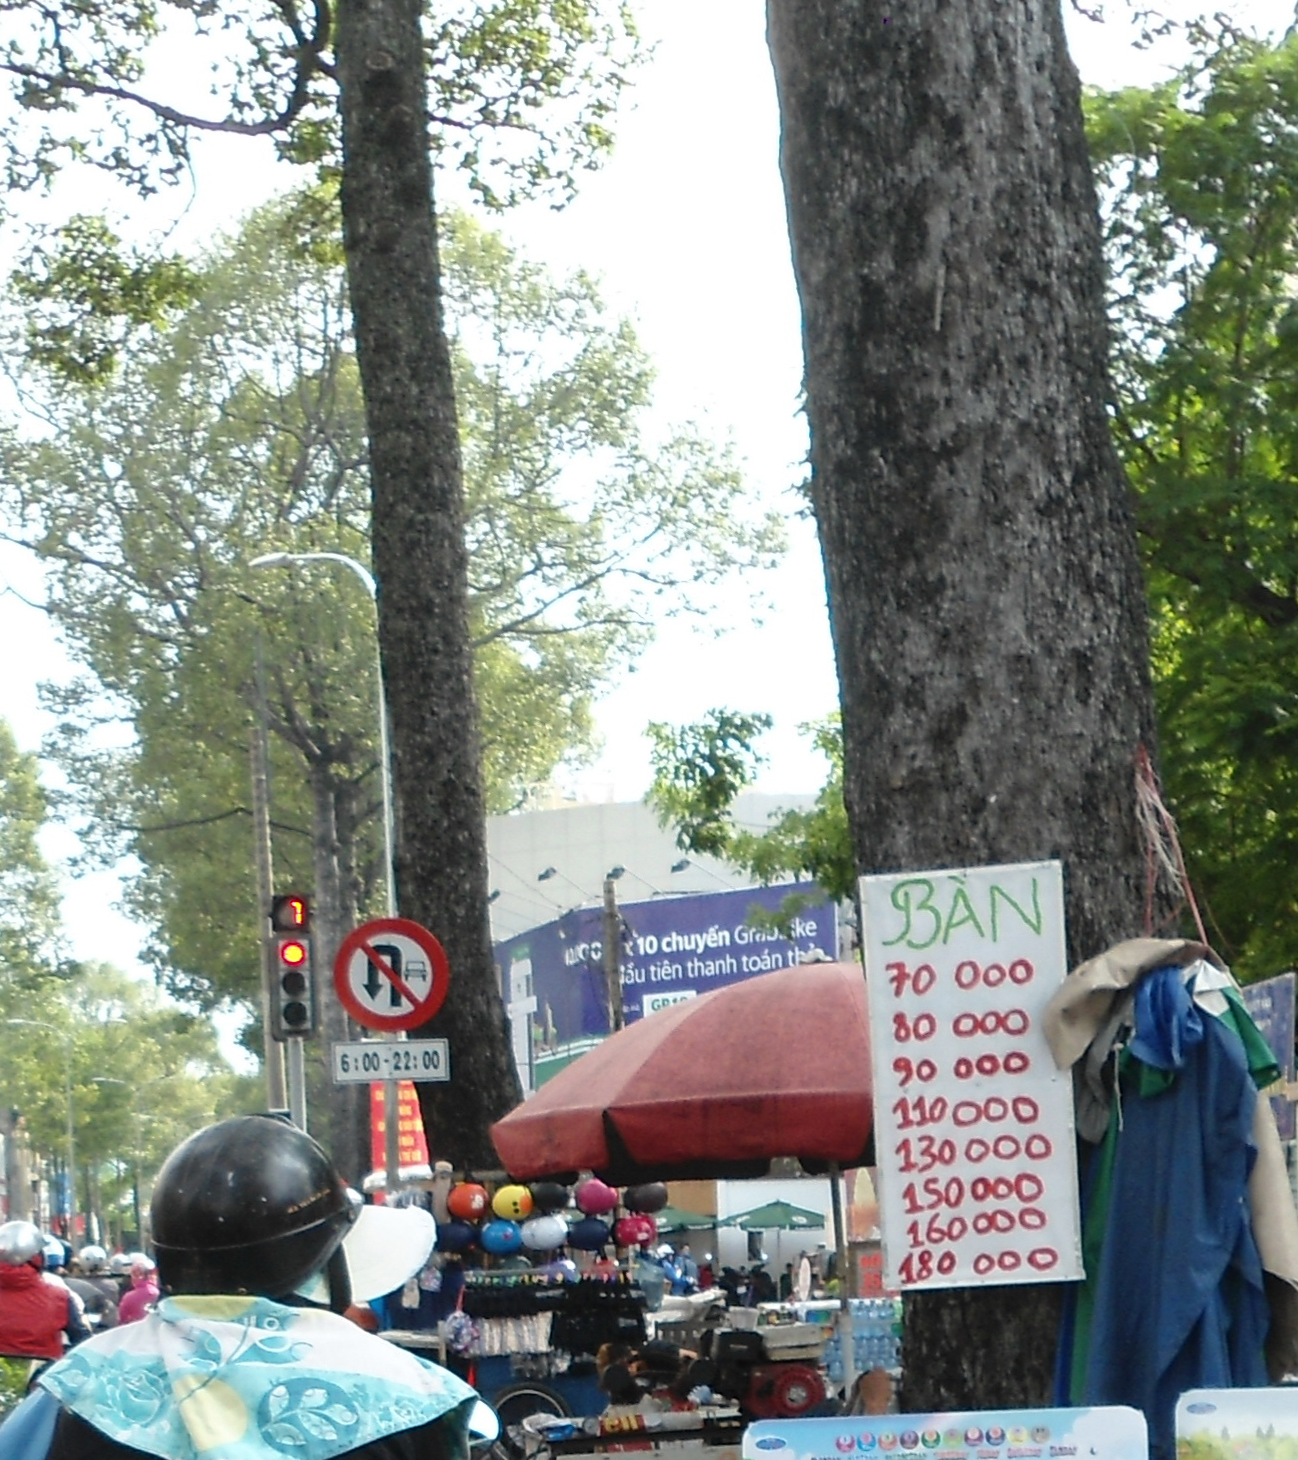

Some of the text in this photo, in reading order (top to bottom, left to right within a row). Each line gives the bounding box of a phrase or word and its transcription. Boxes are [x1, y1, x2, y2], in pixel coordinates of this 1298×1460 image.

[882, 875, 1044, 949] BÀN
[662, 924, 730, 958] chuyến
[650, 959, 683, 981] tiên
[687, 953, 738, 977] thanh
[742, 948, 783, 972] toán
[885, 958, 1035, 997] 70 000
[892, 1009, 1030, 1043] 80 000
[892, 1051, 1030, 1087] 90 000
[898, 1250, 956, 1285] 180
[973, 1247, 1058, 1276] 000
